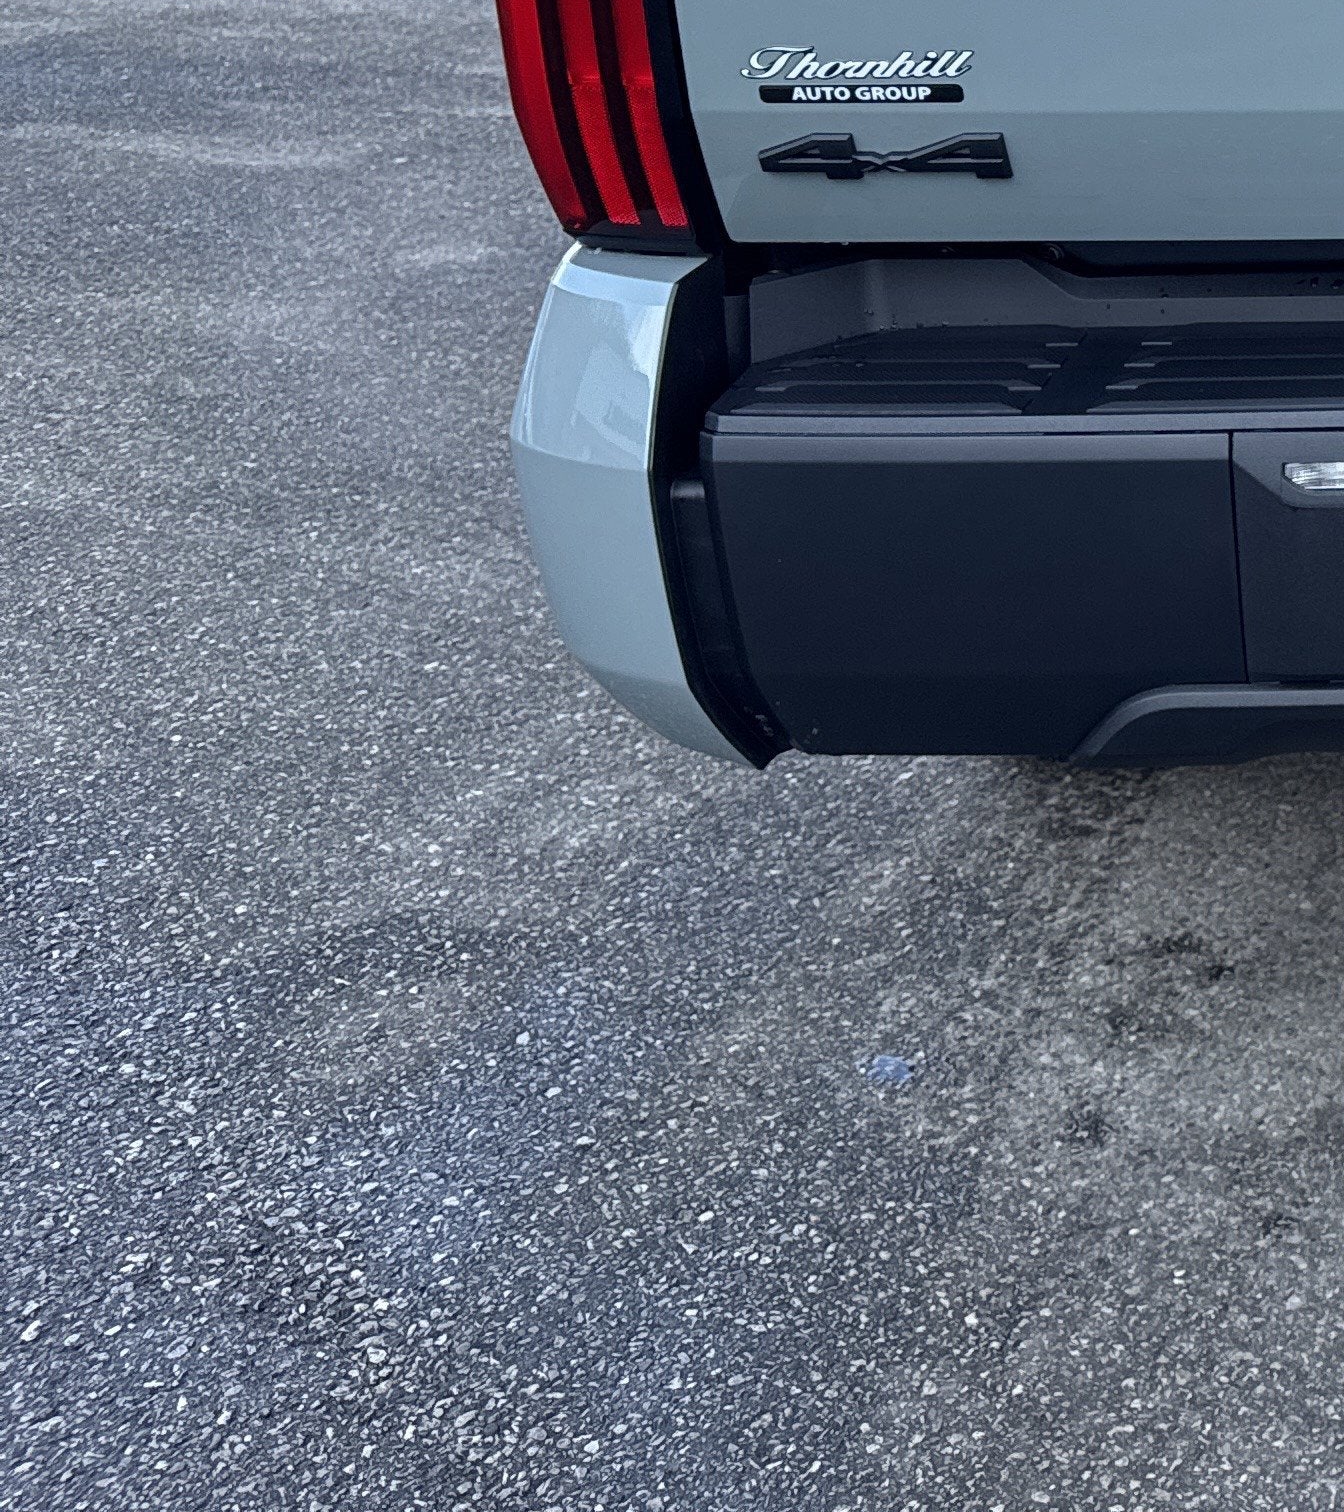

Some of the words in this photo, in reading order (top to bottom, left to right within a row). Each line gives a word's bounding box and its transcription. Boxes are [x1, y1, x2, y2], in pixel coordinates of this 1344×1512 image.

[741, 45, 974, 81] Thornhill
[791, 86, 849, 102] AUTO
[854, 86, 932, 102] GROUP
